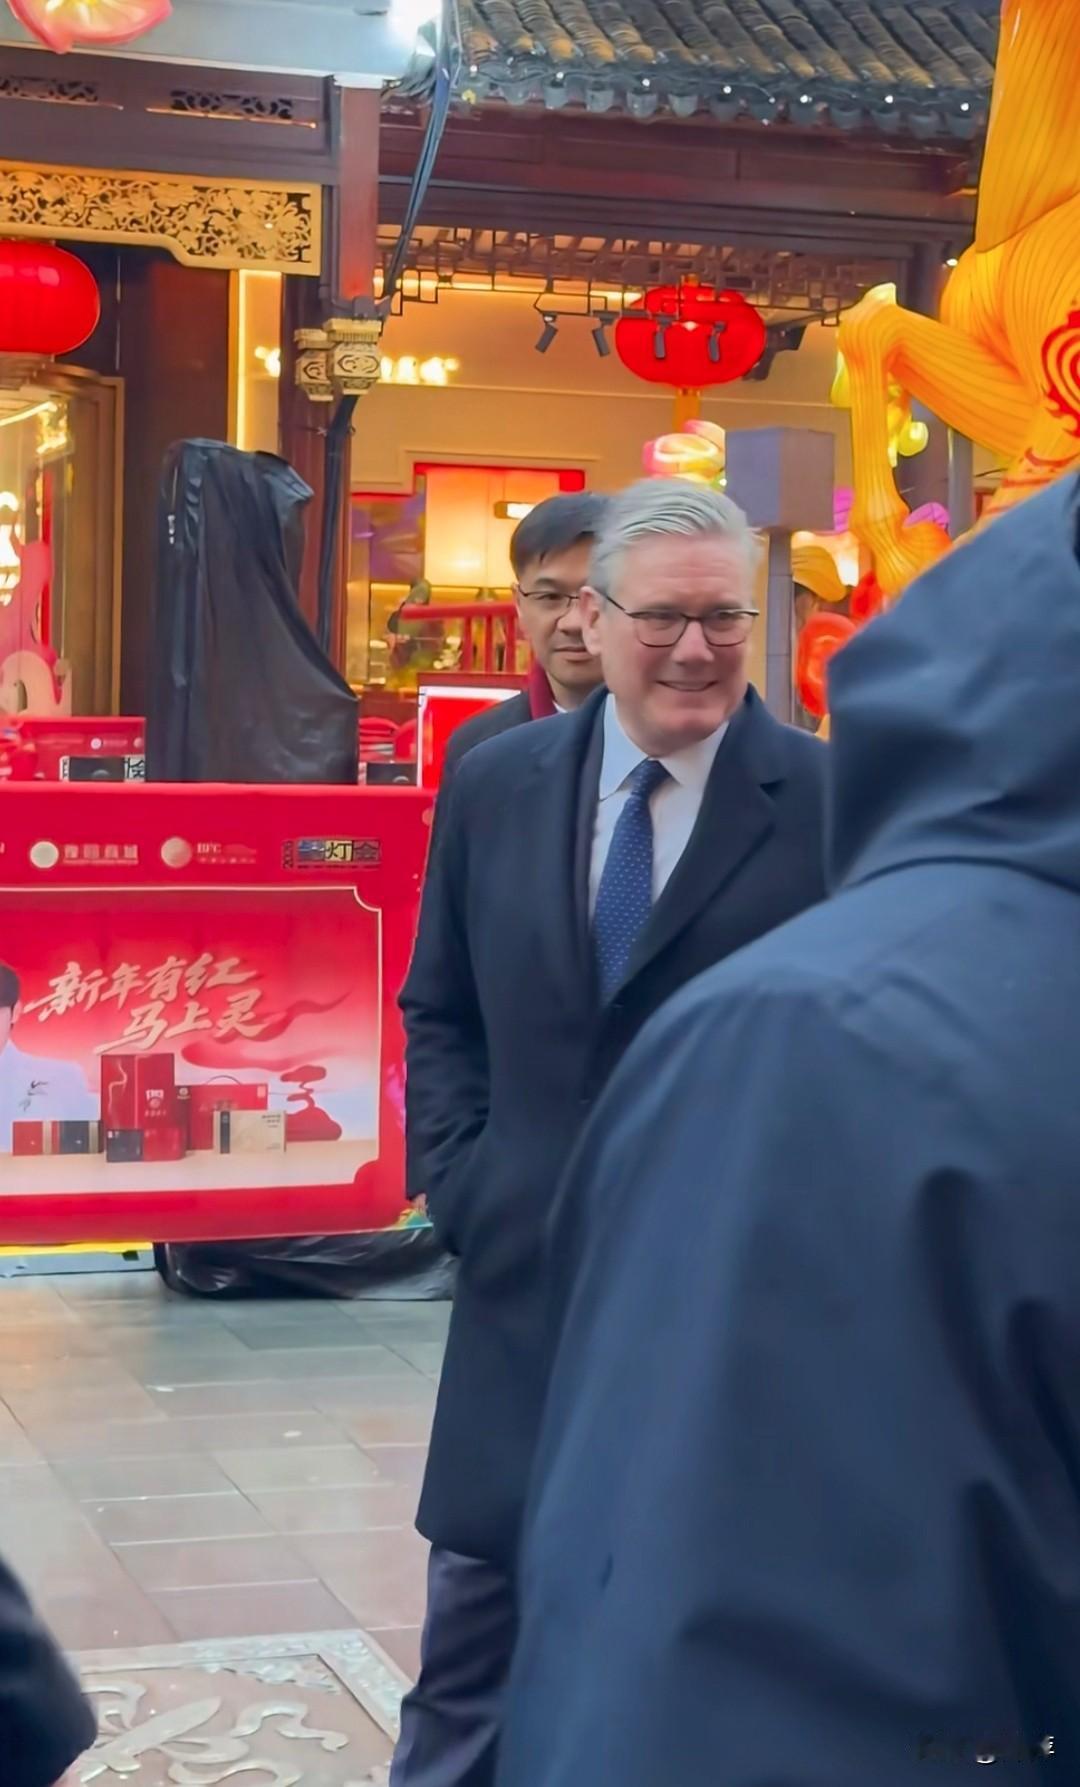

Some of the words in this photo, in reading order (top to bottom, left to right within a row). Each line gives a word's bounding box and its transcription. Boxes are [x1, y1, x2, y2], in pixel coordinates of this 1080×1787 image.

[298, 839, 379, 862] 灯会
[23, 953, 257, 1022] 新年有红
[94, 988, 270, 1055] 马上灵
